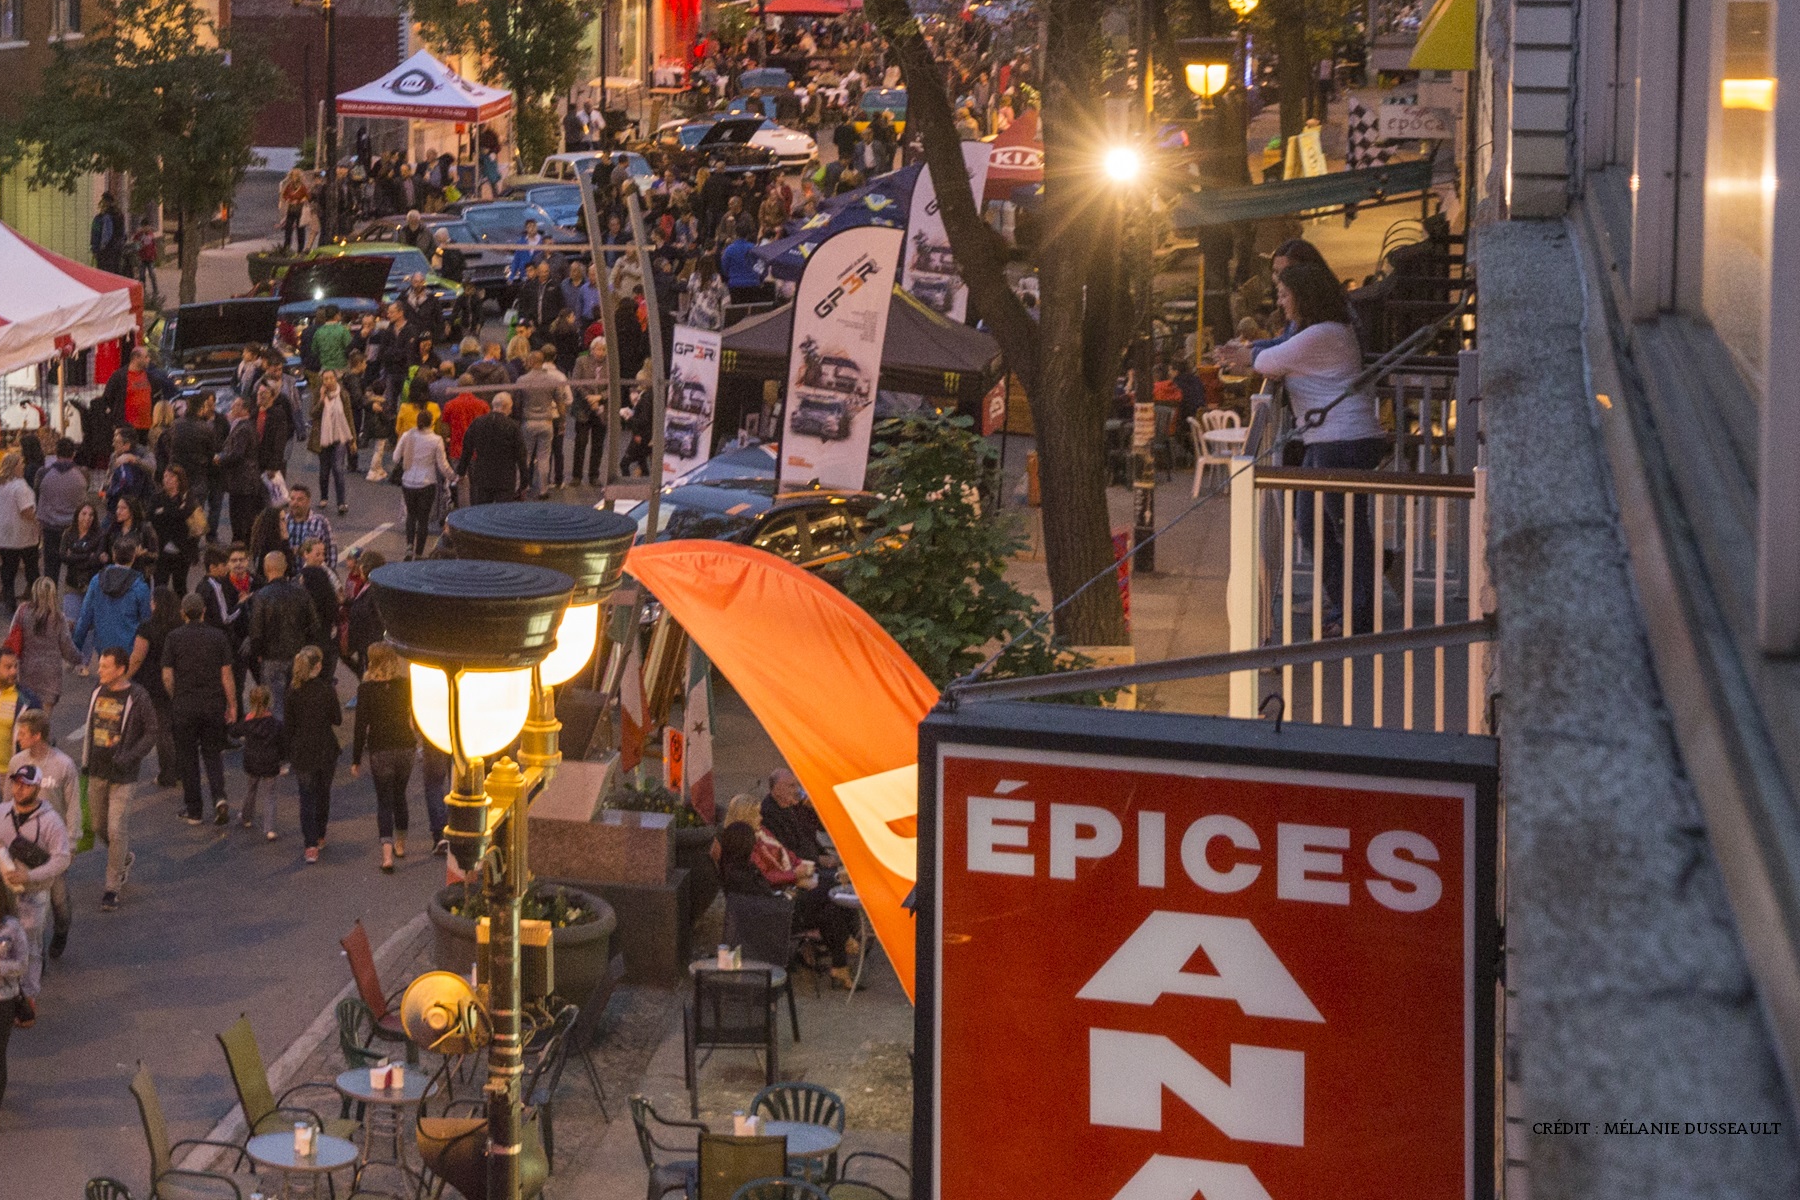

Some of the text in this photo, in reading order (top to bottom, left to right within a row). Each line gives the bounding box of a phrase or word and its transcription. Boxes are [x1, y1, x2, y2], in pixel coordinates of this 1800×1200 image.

[995, 151, 1044, 166] KIA
[674, 342, 716, 362] GP3R
[966, 779, 1443, 913] ÉPICES
